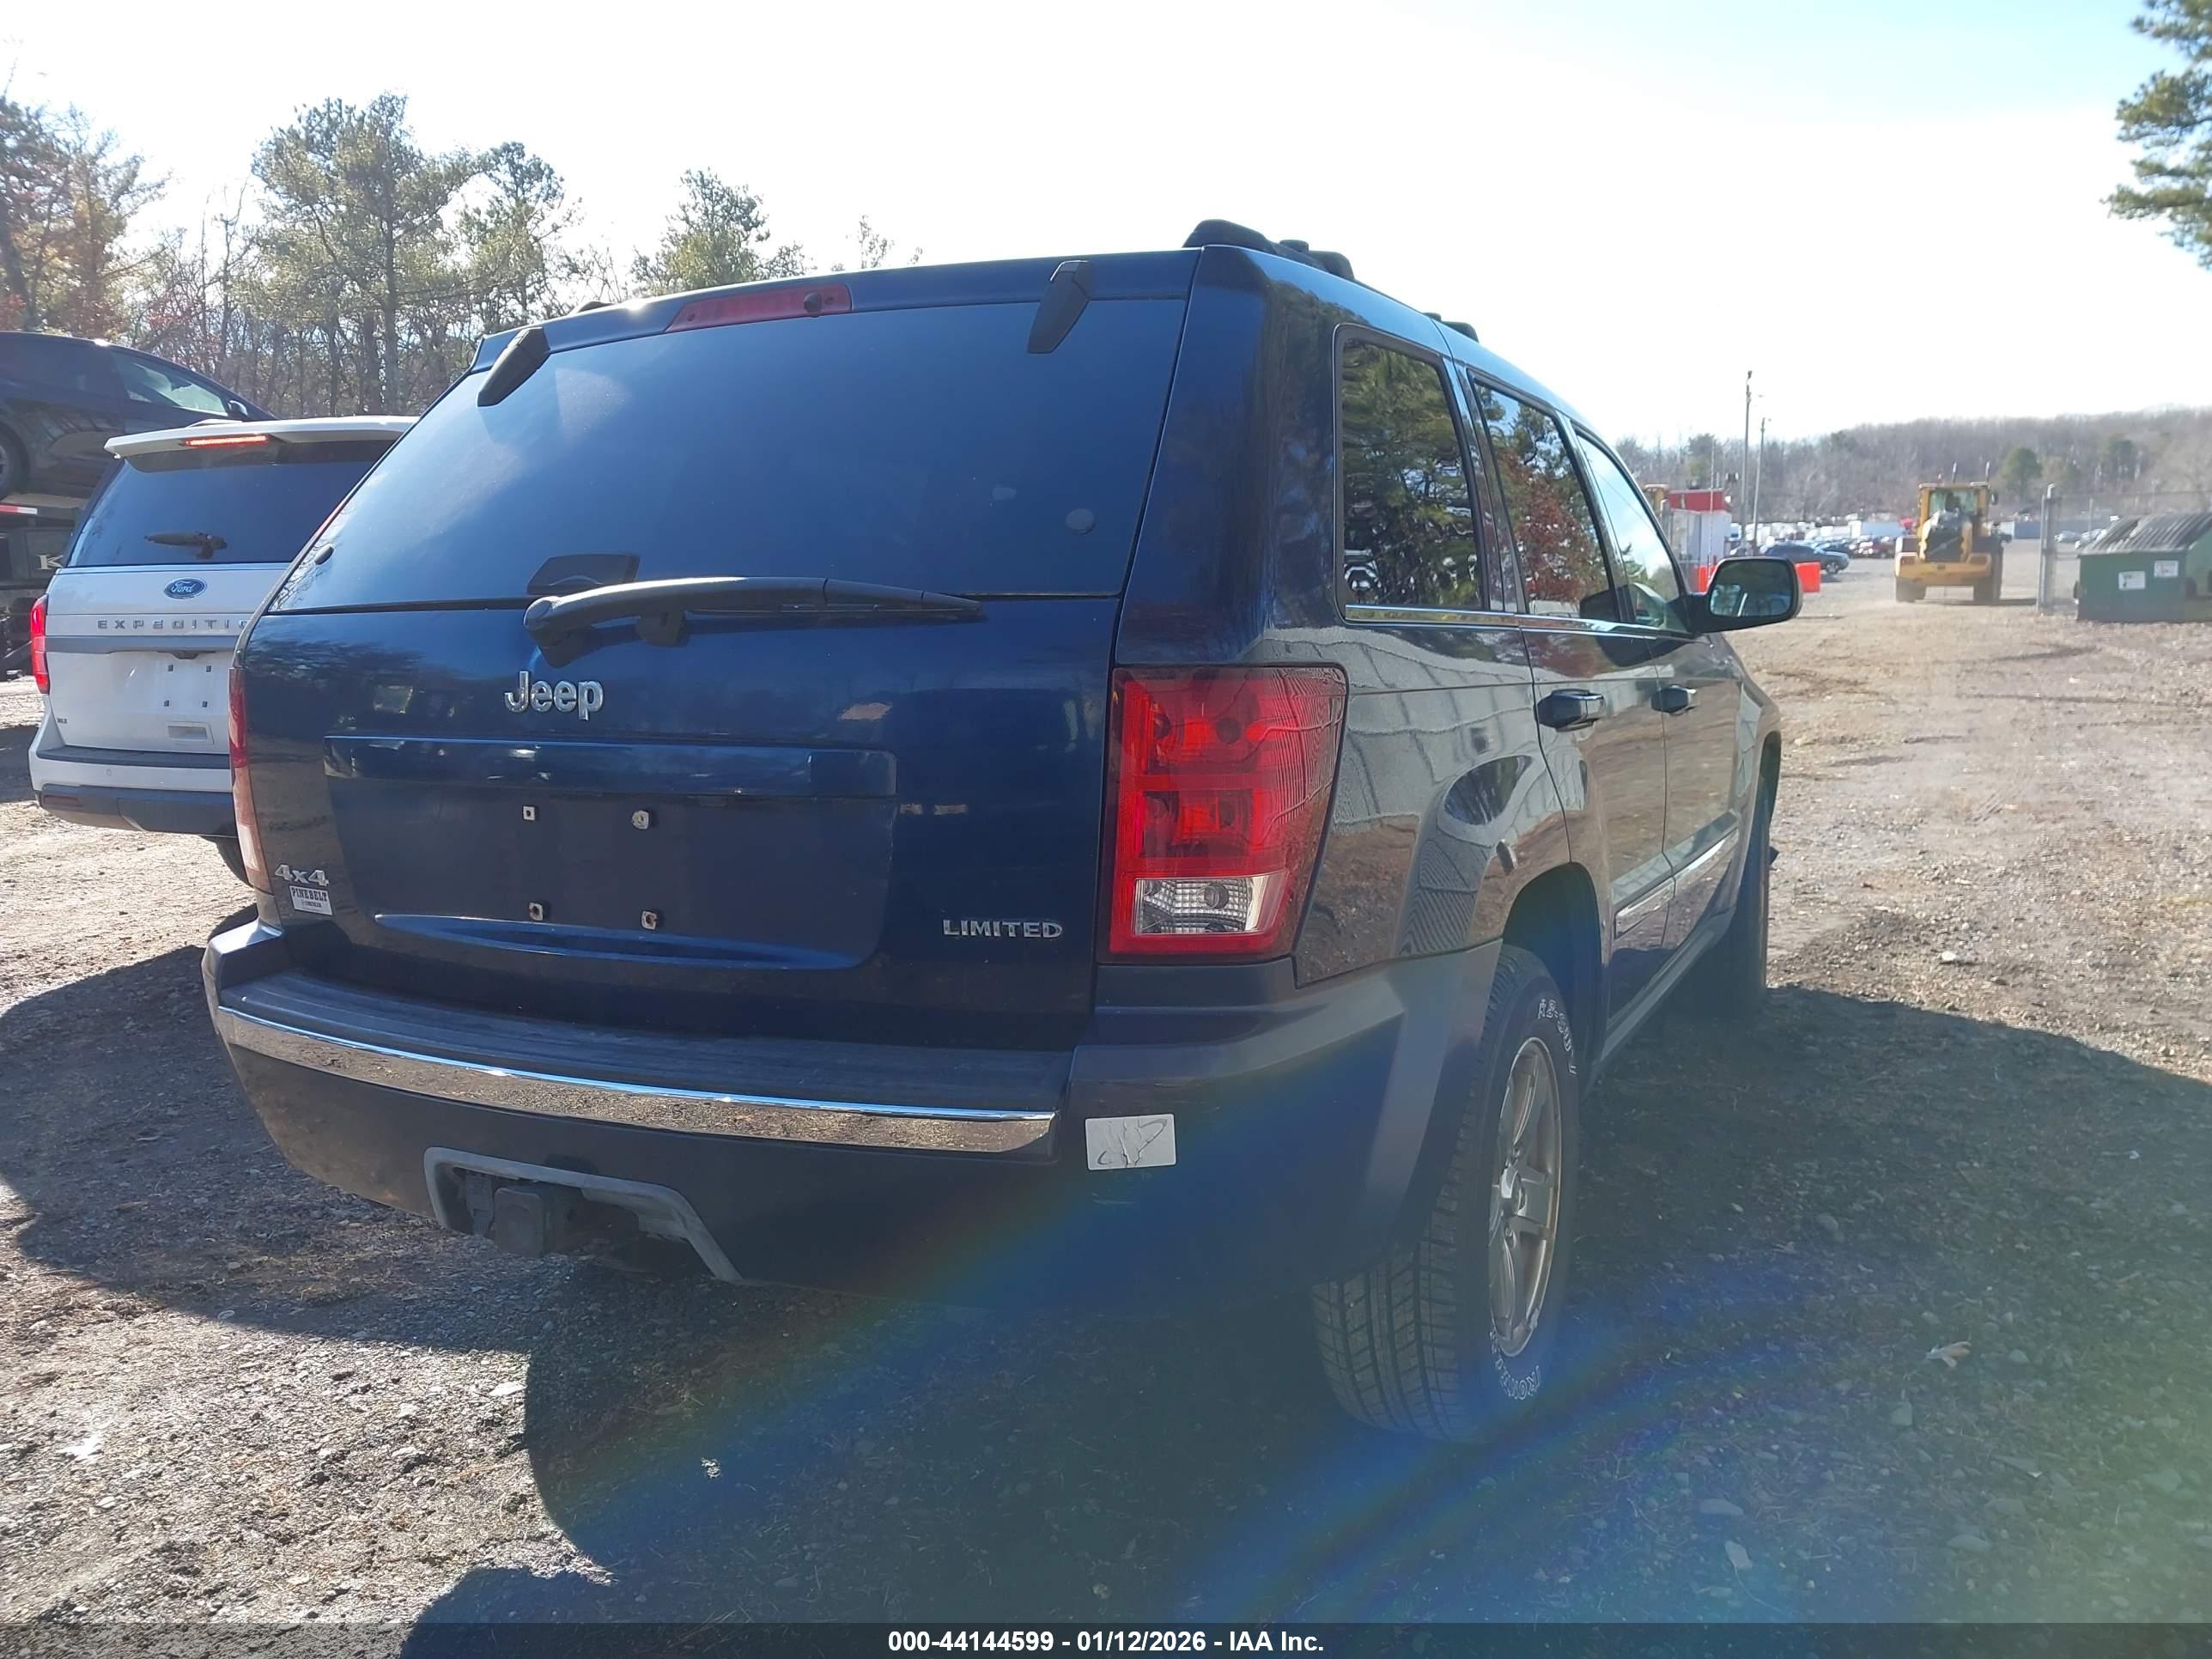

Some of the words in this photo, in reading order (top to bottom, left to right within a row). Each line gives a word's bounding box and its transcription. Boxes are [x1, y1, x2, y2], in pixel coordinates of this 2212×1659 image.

[171, 580, 194, 593] Ford
[503, 670, 605, 721] Jeep
[274, 864, 330, 887] 4x4
[291, 887, 328, 902] PINEBELT
[942, 919, 1064, 939] LIMITED
